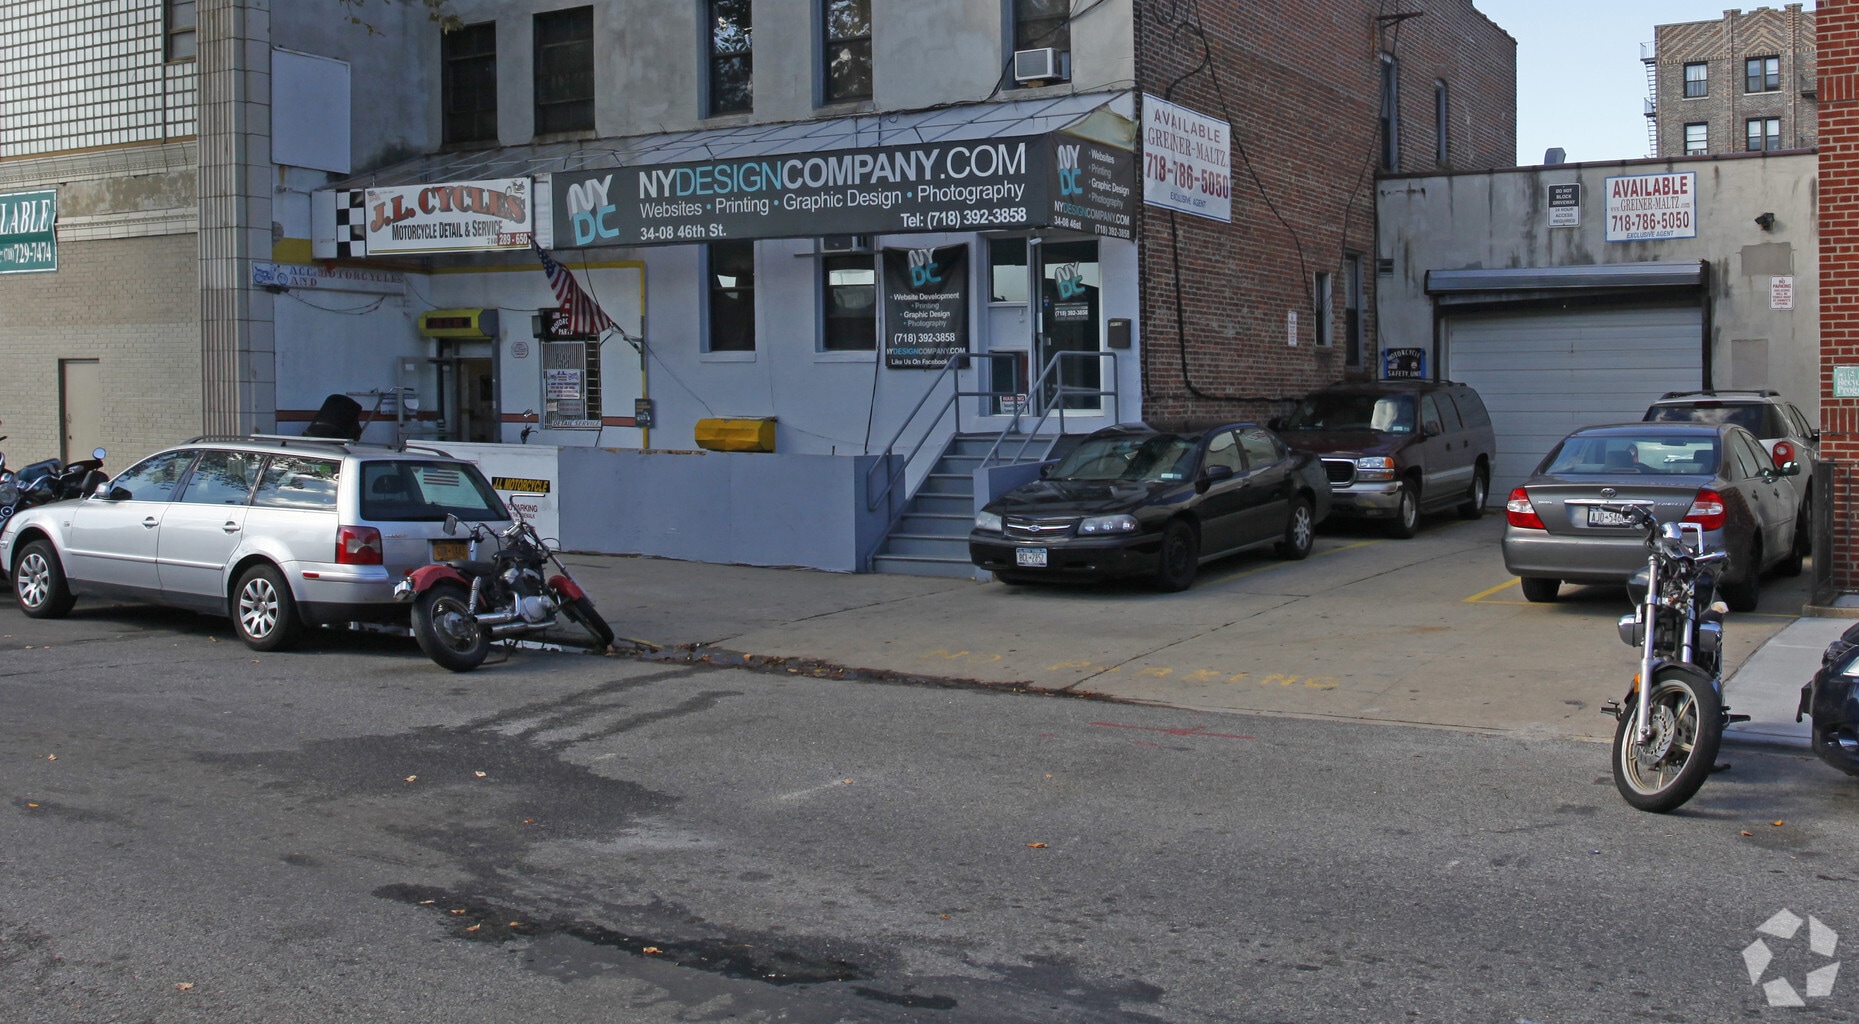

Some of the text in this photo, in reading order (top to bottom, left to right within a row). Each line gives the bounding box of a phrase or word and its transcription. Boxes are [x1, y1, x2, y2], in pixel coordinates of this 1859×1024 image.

[1154, 108, 1220, 144] AVAILABLE
[1057, 144, 1081, 170] NY
[1090, 148, 1115, 164] Websites
[1147, 126, 1226, 167] GREINER-MALTZ
[638, 142, 1027, 200] NYDESIGNCOMPANY.COM
[1060, 168, 1084, 195] DC
[1091, 164, 1112, 179] Printing
[1145, 151, 1229, 200] 718-786-5050
[567, 174, 613, 219] NY
[1091, 177, 1130, 196] Graphic Design
[1612, 175, 1688, 198] AVAILABLE
[370, 184, 527, 233] J.L. CYCLES
[639, 179, 1026, 219] Websites Printing Graphic Design Photography
[1091, 192, 1124, 210] Photography
[1192, 198, 1207, 208] AGENT
[0, 199, 51, 235] LABLE
[900, 207, 1027, 230] Tel: (718) 392-3858
[1053, 216, 1069, 227] 34-08
[1054, 200, 1130, 226] NYDESIGNCOMPANY.COM
[1611, 211, 1690, 232] 718-786-5050
[391, 220, 503, 241] MOTORCYCLE DETAIL & SERVICE
[573, 204, 620, 246] DC
[640, 223, 727, 241] 34-08 46th St.
[1094, 223, 1130, 239] (718) 392-3858
[1626, 230, 1655, 239] EXCLUSIVE
[14, 241, 52, 264] 729-7474
[908, 247, 936, 269] NY
[290, 276, 317, 287] AND
[911, 262, 941, 287] DC
[1055, 261, 1080, 283] NY
[893, 292, 960, 302] Website Development
[1058, 275, 1086, 299] DC
[903, 310, 951, 320] Graphic Design
[914, 302, 940, 310] Printing
[907, 319, 947, 329] Photography
[894, 332, 956, 344] (718) 392-3858
[504, 478, 548, 492] MOTORCYCLE
